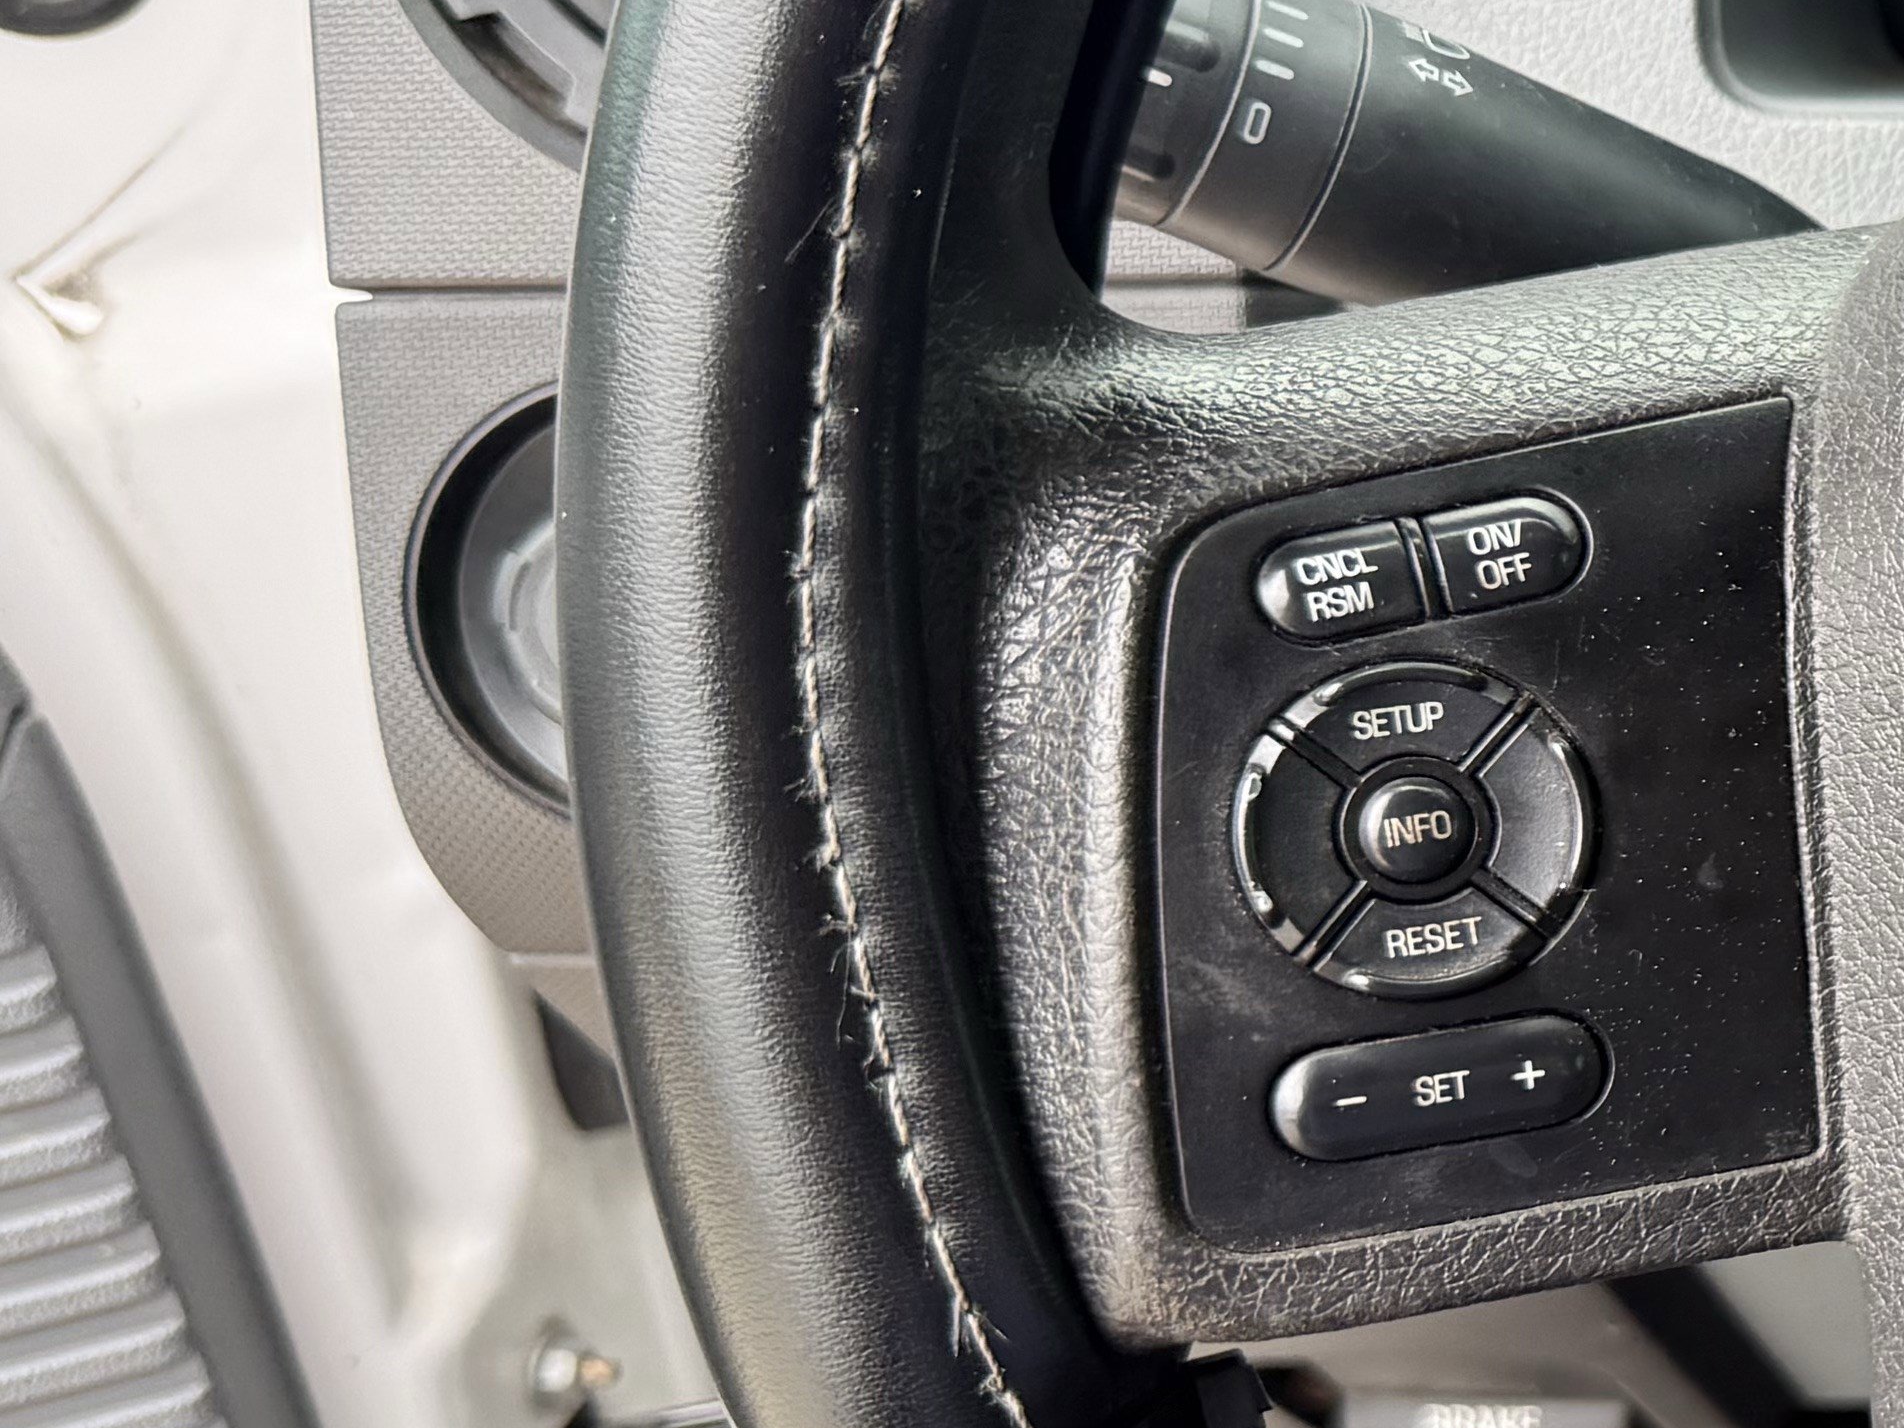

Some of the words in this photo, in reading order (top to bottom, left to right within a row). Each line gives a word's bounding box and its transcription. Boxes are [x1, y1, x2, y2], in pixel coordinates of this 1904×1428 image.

[1467, 520, 1522, 556] ON/
[1295, 547, 1379, 586] CNCL
[1477, 552, 1532, 590] OFF
[1306, 581, 1375, 623] RSM
[1352, 701, 1445, 741] SETUP
[1384, 809, 1452, 848] INFO
[1384, 916, 1482, 959] RESET
[1413, 1070, 1470, 1107] SET
